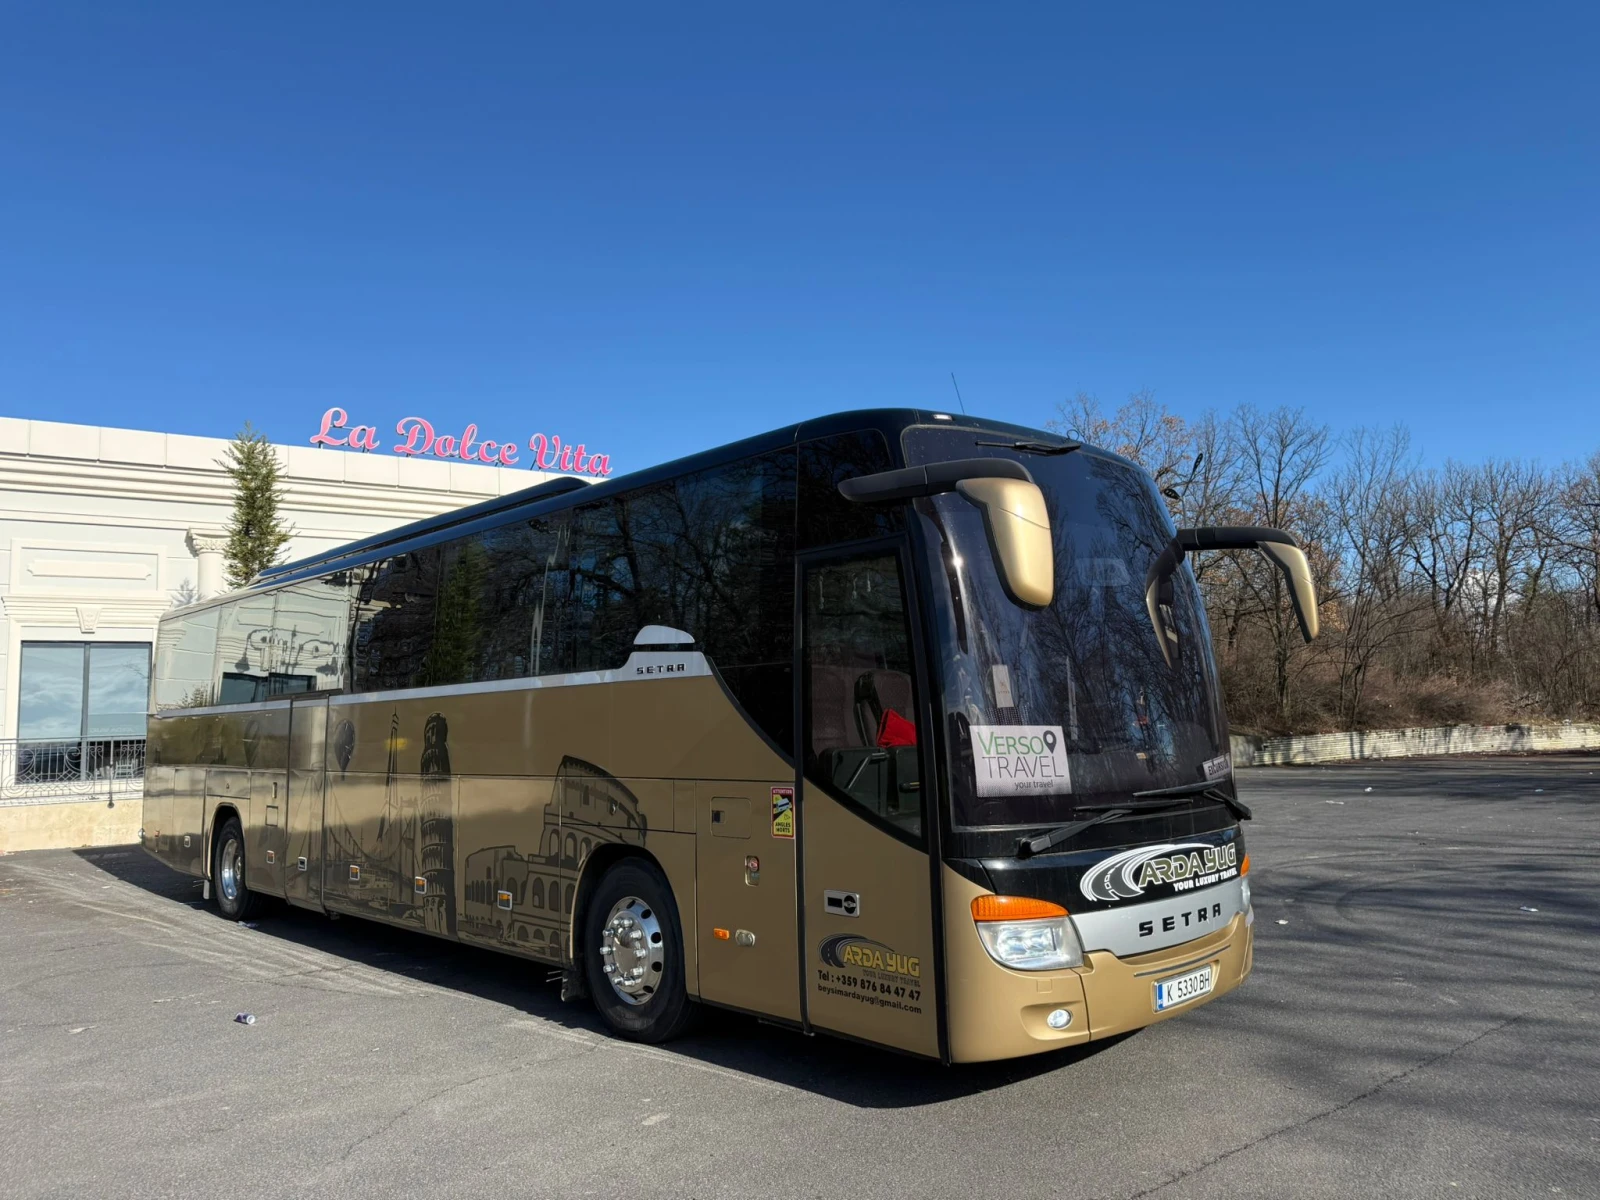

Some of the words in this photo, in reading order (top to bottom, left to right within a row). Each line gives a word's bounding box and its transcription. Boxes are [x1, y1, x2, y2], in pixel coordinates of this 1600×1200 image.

[309, 407, 380, 450] La
[393, 416, 519, 465] Dolce
[528, 432, 612, 475] Vita
[636, 663, 685, 675] SETRA
[977, 731, 1044, 755] VERSO
[982, 756, 1064, 778] TRAVEL
[1014, 781, 1032, 790] your
[1033, 779, 1054, 788] travel
[1138, 852, 1204, 888] ARDA
[1173, 880, 1194, 892] YOUR
[1195, 872, 1219, 887] LUXURY
[1219, 866, 1238, 880] TRAVEL
[1138, 903, 1221, 938] SETRA
[843, 945, 886, 973] ARDA
[860, 978, 877, 992] 876
[879, 982, 892, 996] 84
[893, 986, 906, 998] 47
[908, 990, 921, 1002] 47
[1167, 983, 1174, 1003] K
[1177, 975, 1198, 998] 5330
